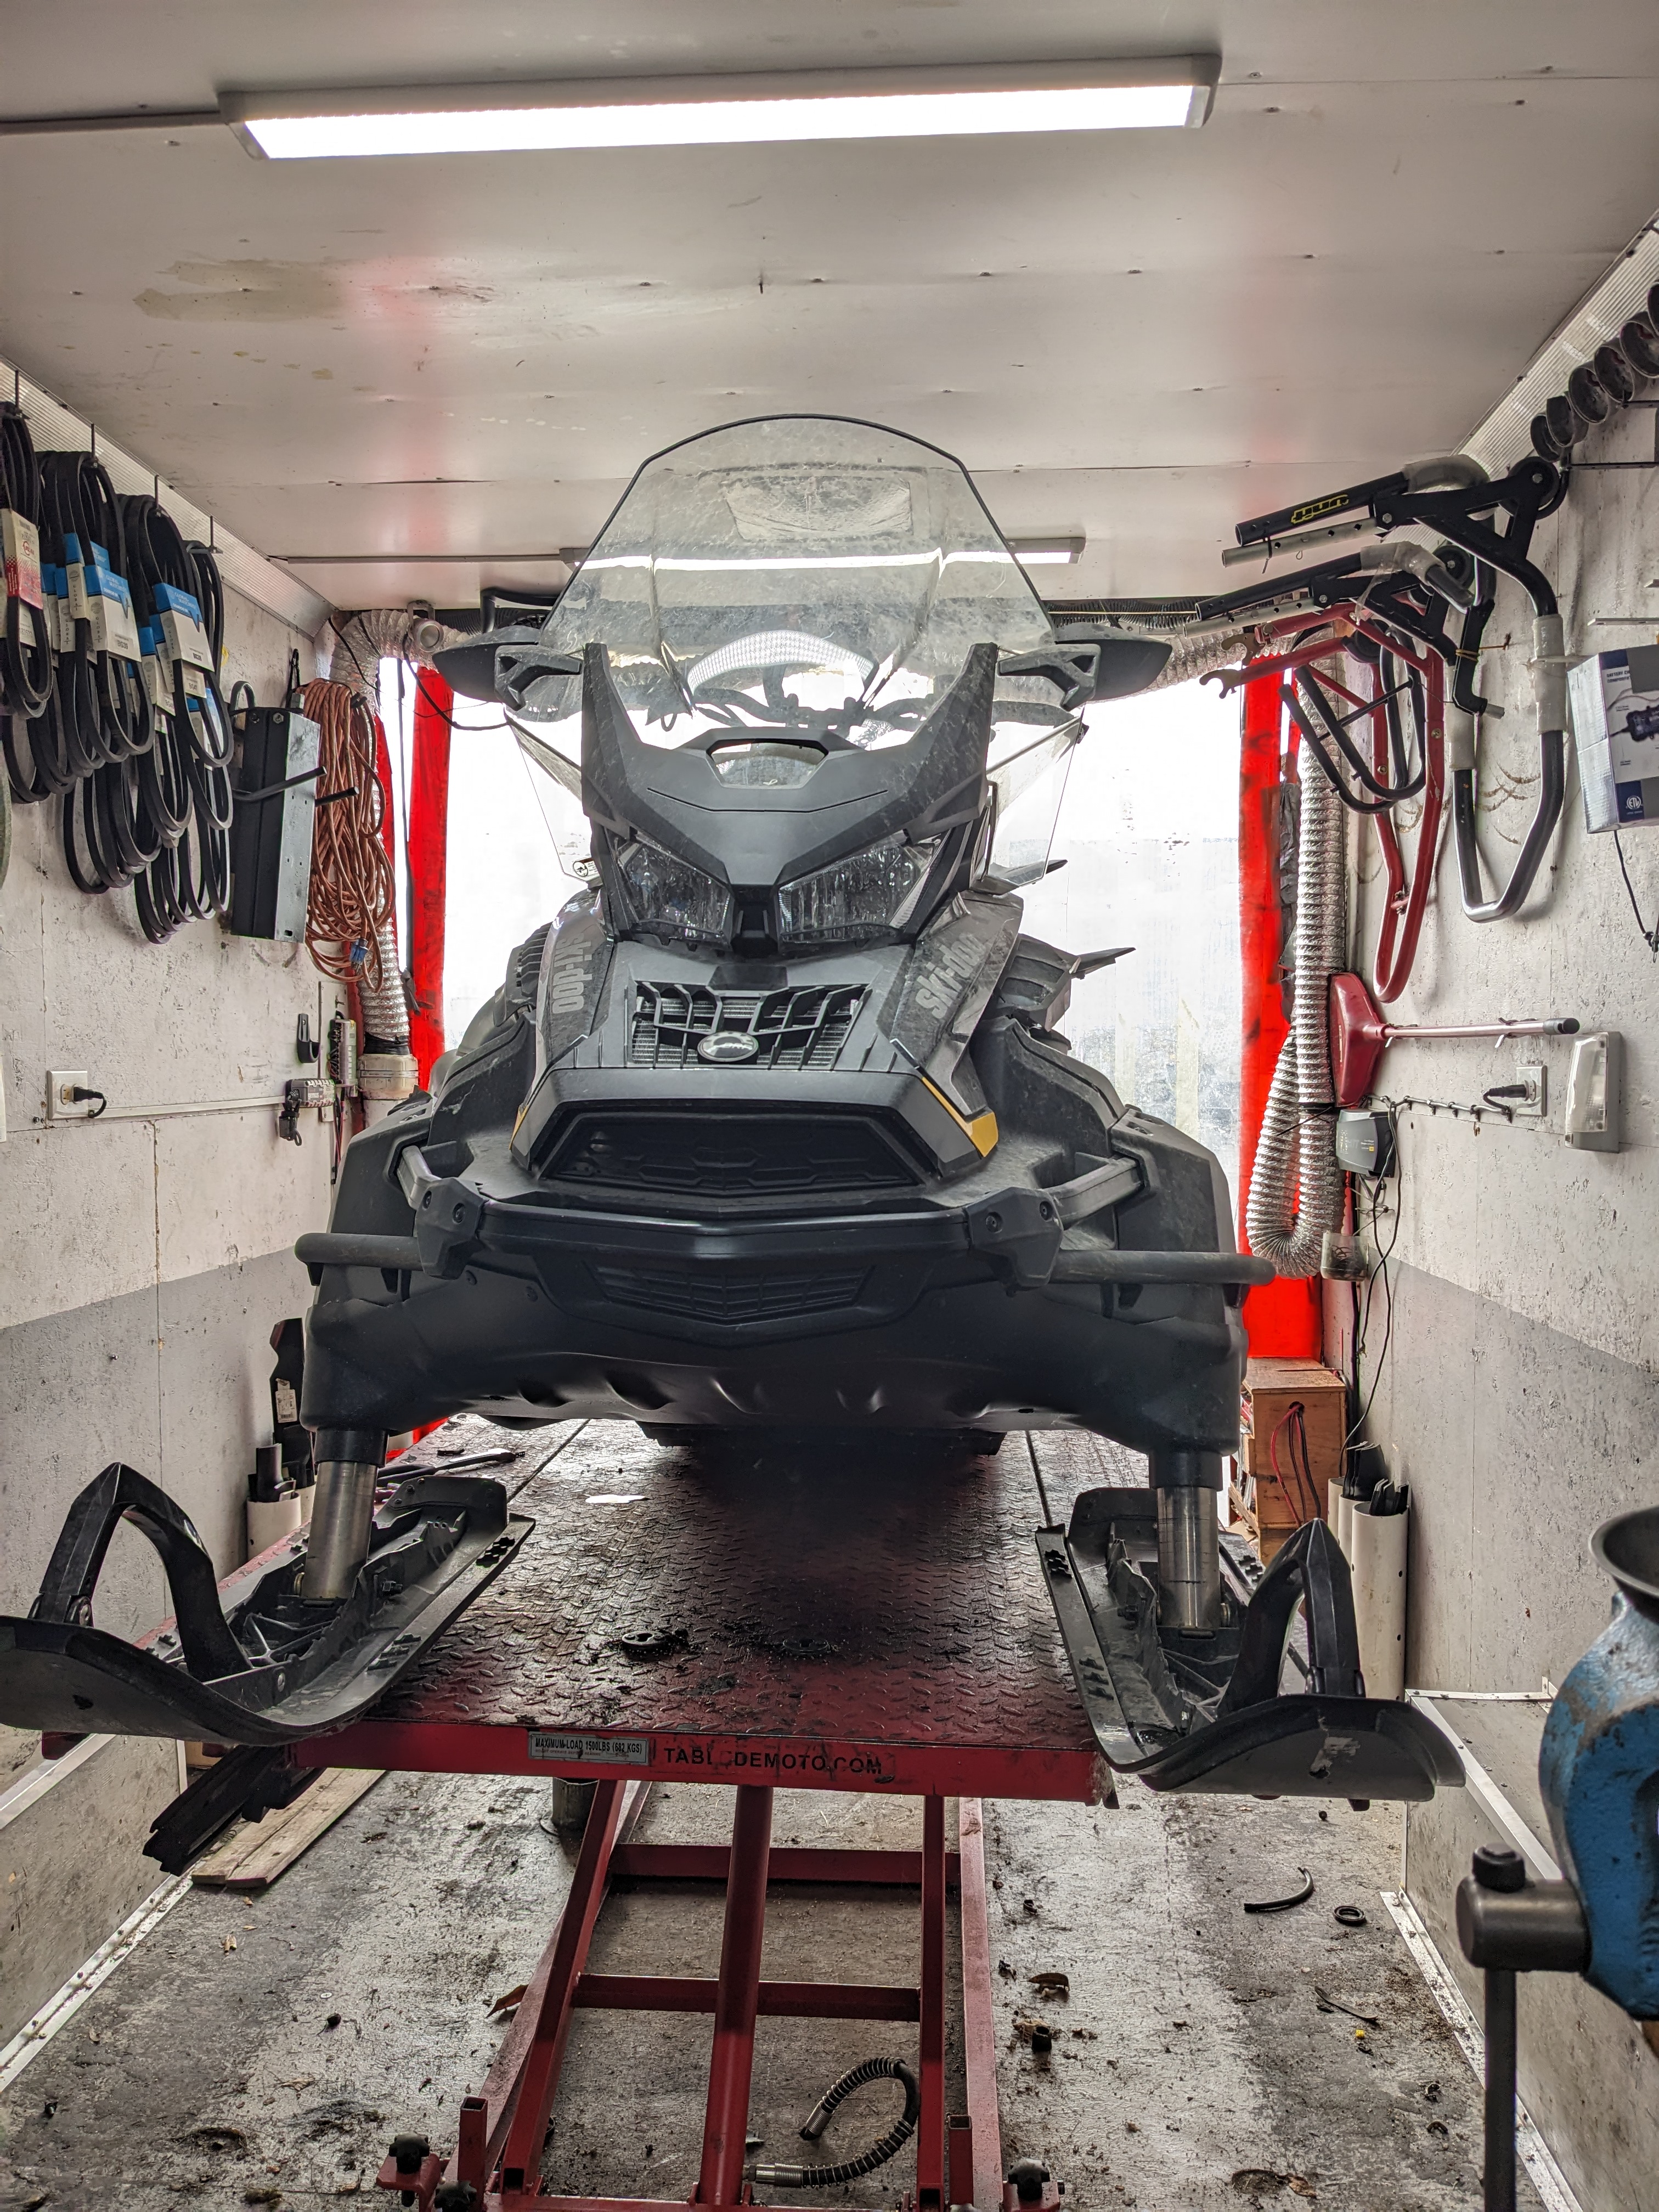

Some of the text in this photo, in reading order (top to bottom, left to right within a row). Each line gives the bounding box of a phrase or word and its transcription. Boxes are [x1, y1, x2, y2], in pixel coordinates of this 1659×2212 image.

[551, 933, 592, 1014] ski-doo
[916, 933, 986, 1019] ski-doo
[535, 1738, 565, 1748] MAXIMUM
[567, 1740, 583, 1750] LOAD
[585, 1741, 610, 1752] 1500LBS
[612, 1742, 625, 1753] (682
[627, 1743, 642, 1754] KGS)
